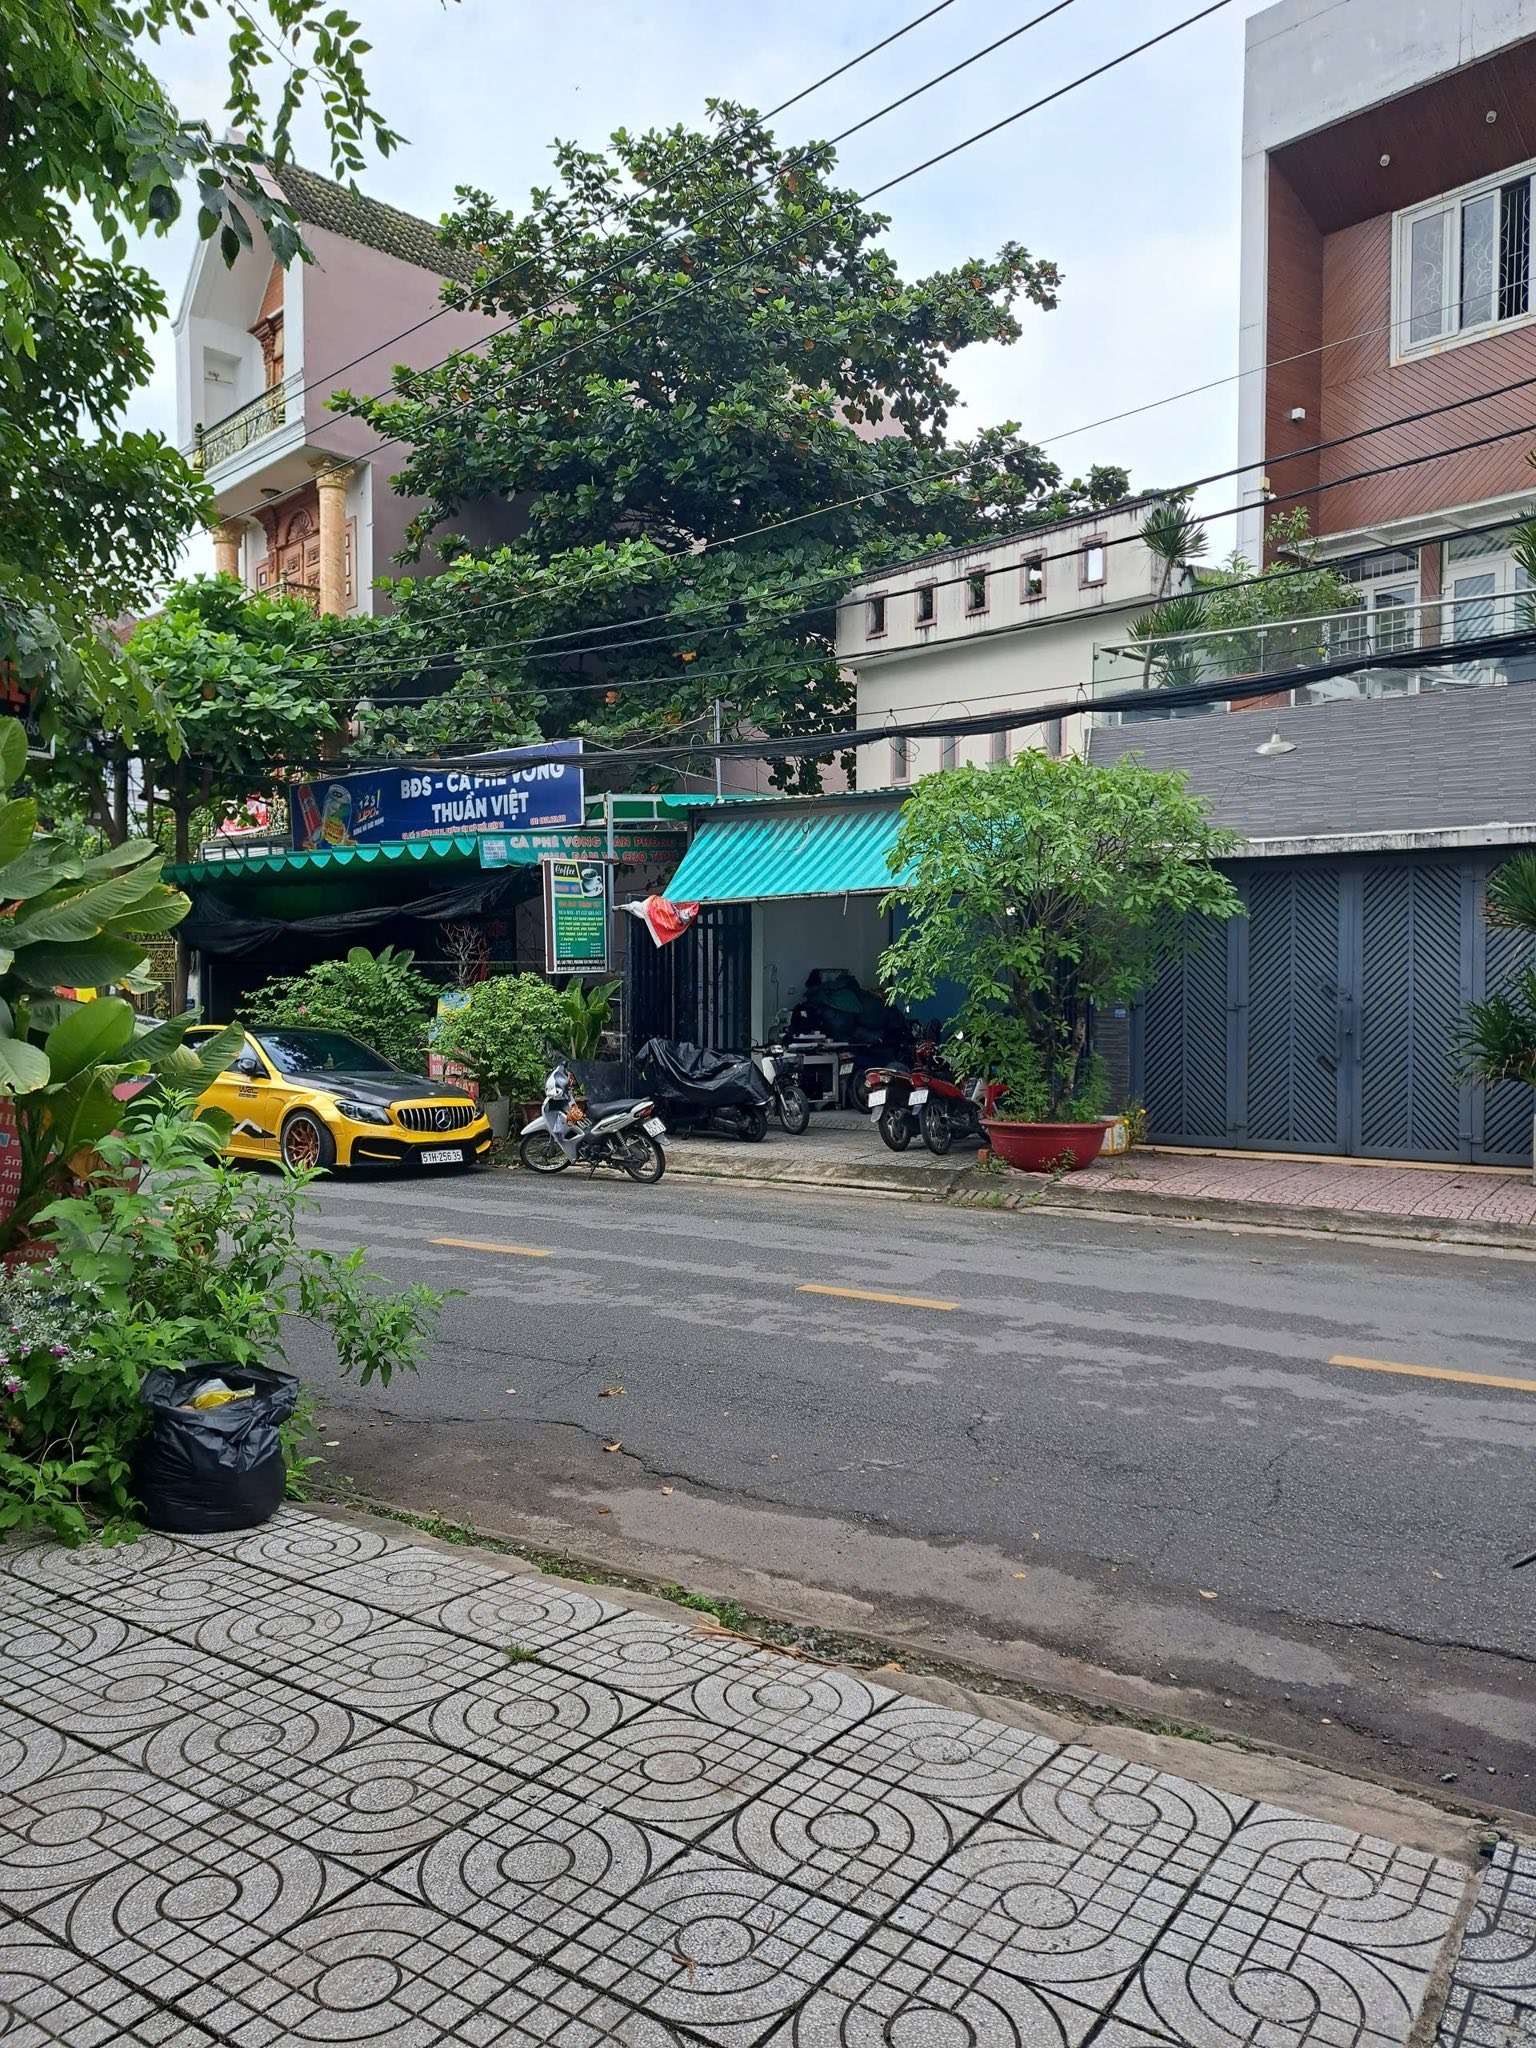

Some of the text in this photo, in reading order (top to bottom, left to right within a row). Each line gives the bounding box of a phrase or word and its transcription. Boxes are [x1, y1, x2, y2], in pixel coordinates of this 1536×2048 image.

[401, 776, 432, 799] BĐS
[431, 788, 529, 823] THUẦN VIỆT
[509, 834, 529, 848] CÀ
[532, 834, 560, 848] PHÊ
[622, 850, 647, 863] CHO
[555, 863, 576, 877] Coffee
